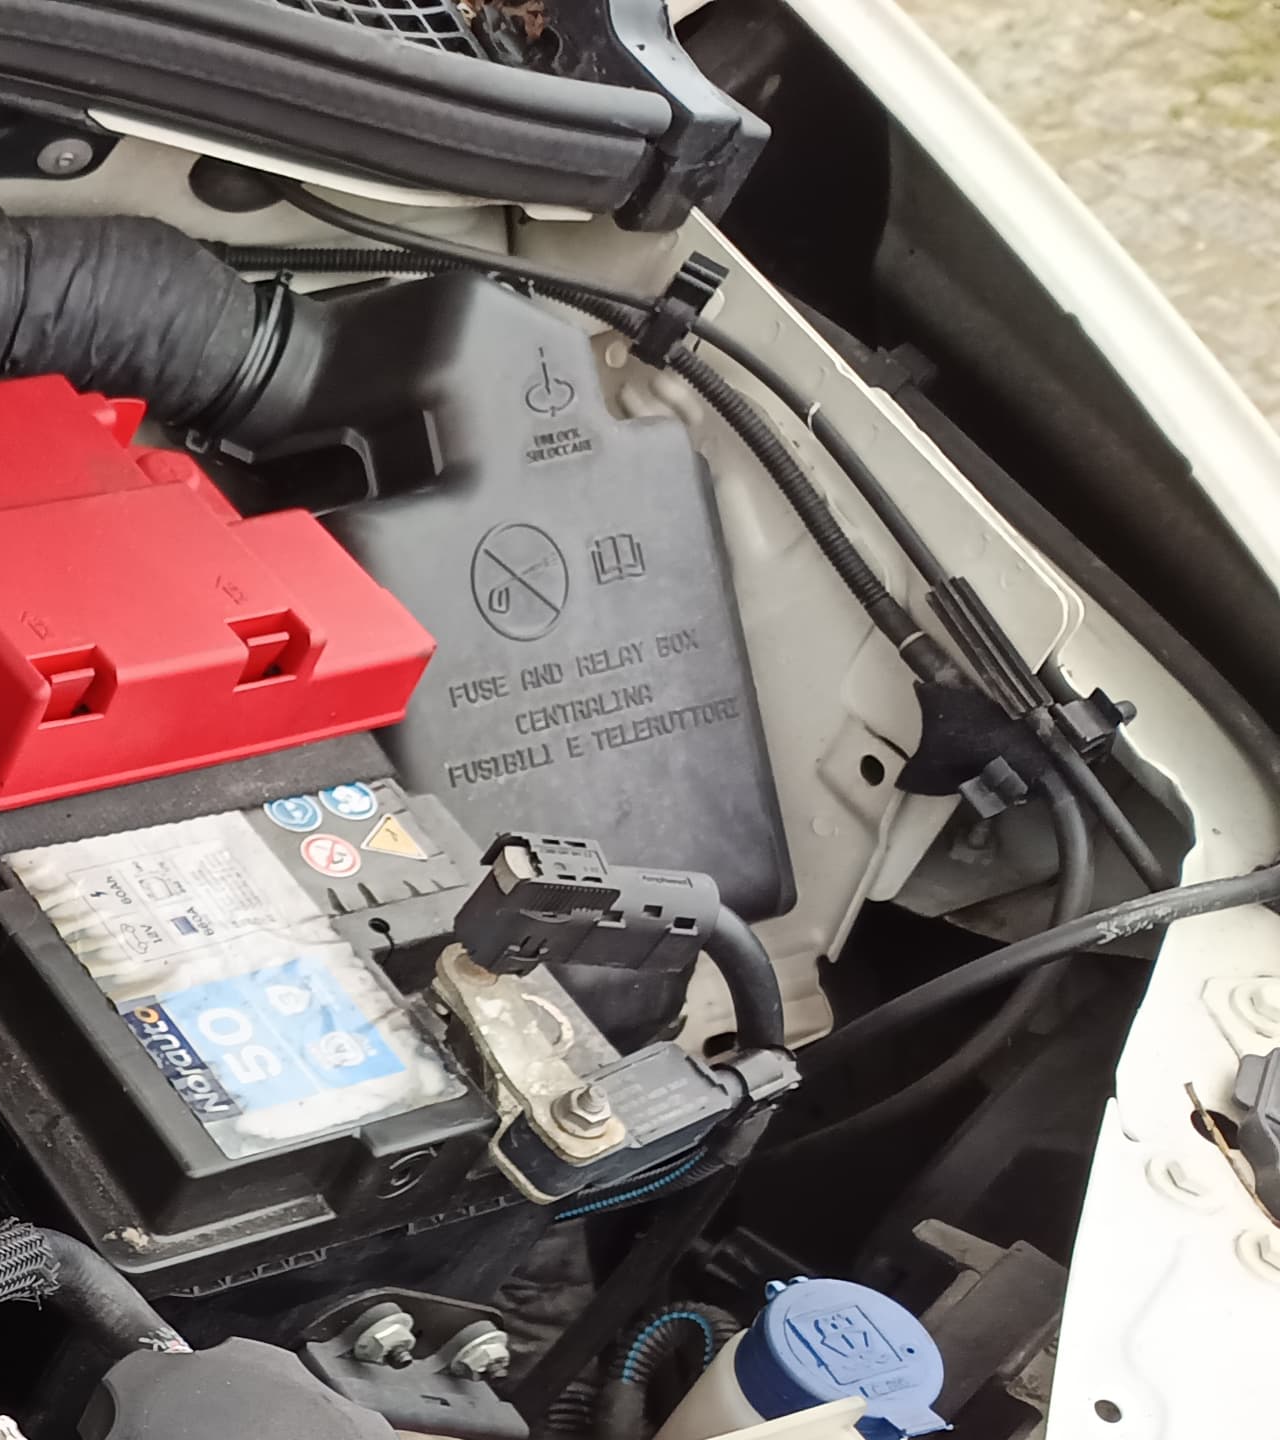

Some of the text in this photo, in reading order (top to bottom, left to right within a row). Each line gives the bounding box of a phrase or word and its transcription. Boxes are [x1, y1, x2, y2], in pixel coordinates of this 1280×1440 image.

[533, 427, 581, 447] UNLOCK
[448, 631, 700, 708] FUSE AND RELAY BOX
[448, 698, 740, 788] FUSIBILI E TELERUTTORI
[515, 684, 655, 735] CENTRALINA
[132, 1005, 231, 1114] Norauto
[196, 1006, 284, 1084] 50
